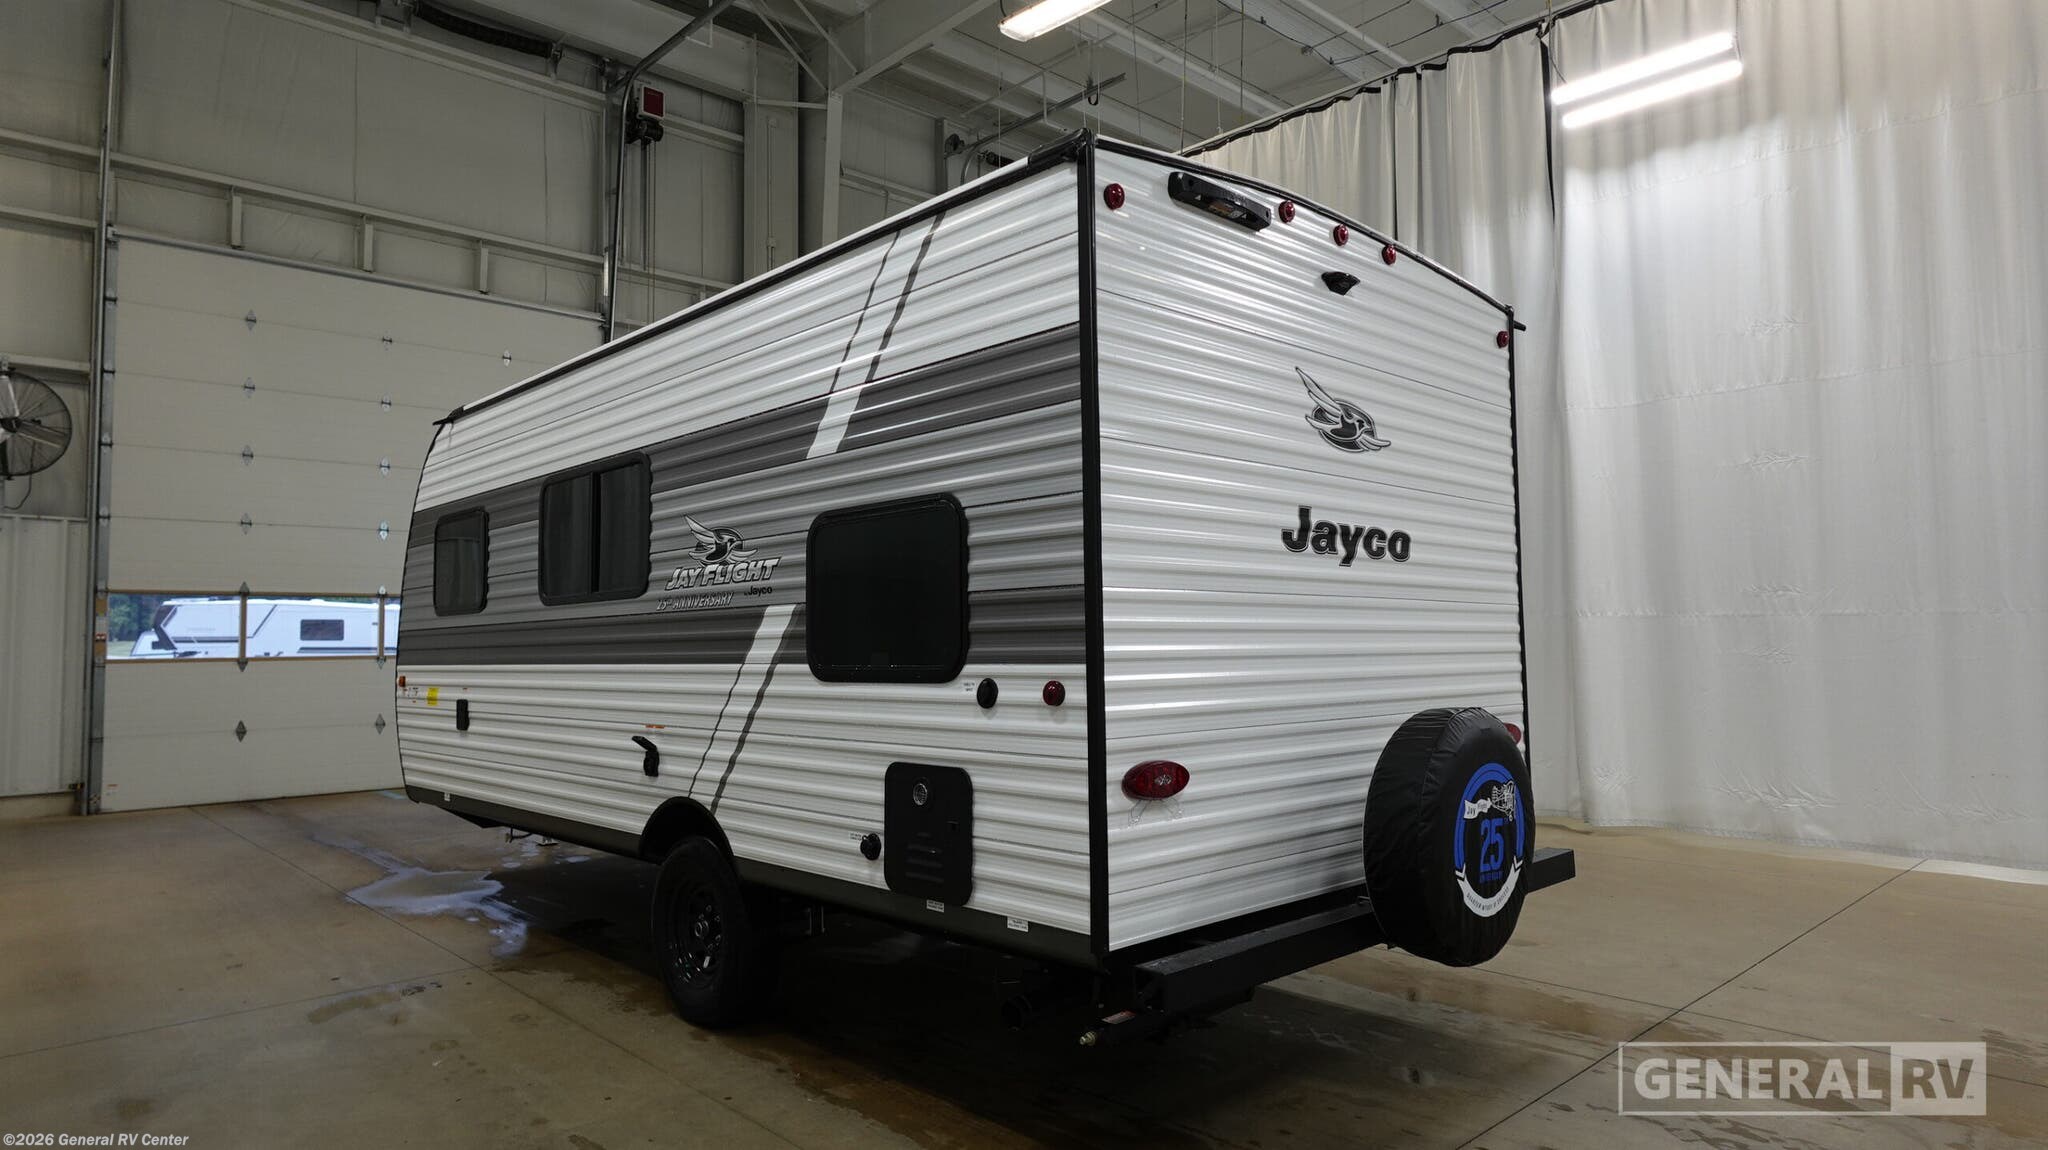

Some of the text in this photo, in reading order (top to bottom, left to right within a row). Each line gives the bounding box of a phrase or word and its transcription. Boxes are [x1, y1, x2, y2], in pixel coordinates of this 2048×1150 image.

[1281, 504, 1411, 567] Jayco
[665, 557, 781, 590] JAY FLIGHT
[672, 592, 735, 609] ANNIVERSARY
[748, 586, 773, 597] Jayco
